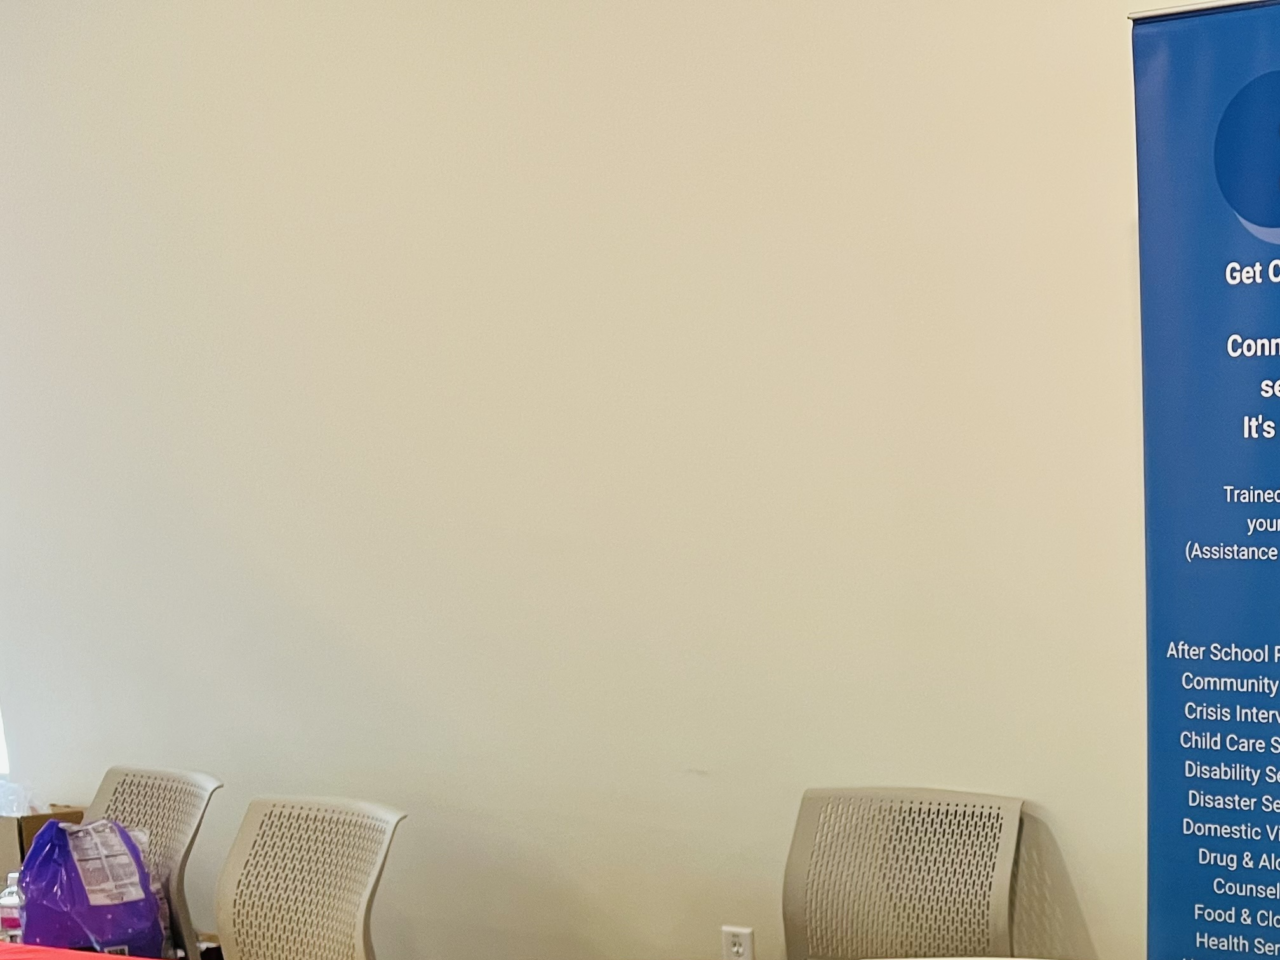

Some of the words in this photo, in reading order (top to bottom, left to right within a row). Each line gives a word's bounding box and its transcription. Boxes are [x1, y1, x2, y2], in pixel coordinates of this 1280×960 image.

[1225, 262, 1262, 284] Get
[1243, 415, 1275, 438] It's
[1186, 541, 1278, 563] (Assistance
[1167, 641, 1205, 660] After
[1210, 643, 1269, 663] School
[1182, 672, 1278, 697] Community
[1185, 702, 1231, 721] Crisis
[1180, 731, 1220, 750] Child
[1226, 735, 1265, 753] Care
[1185, 760, 1260, 785] Disability
[1188, 790, 1256, 811] Disaster
[1183, 818, 1261, 841] Domestic
[1199, 848, 1237, 871] Drug
[1242, 852, 1253, 868] &
[1195, 905, 1235, 924] Food
[1241, 908, 1252, 925] &
[1196, 933, 1249, 952] Health
